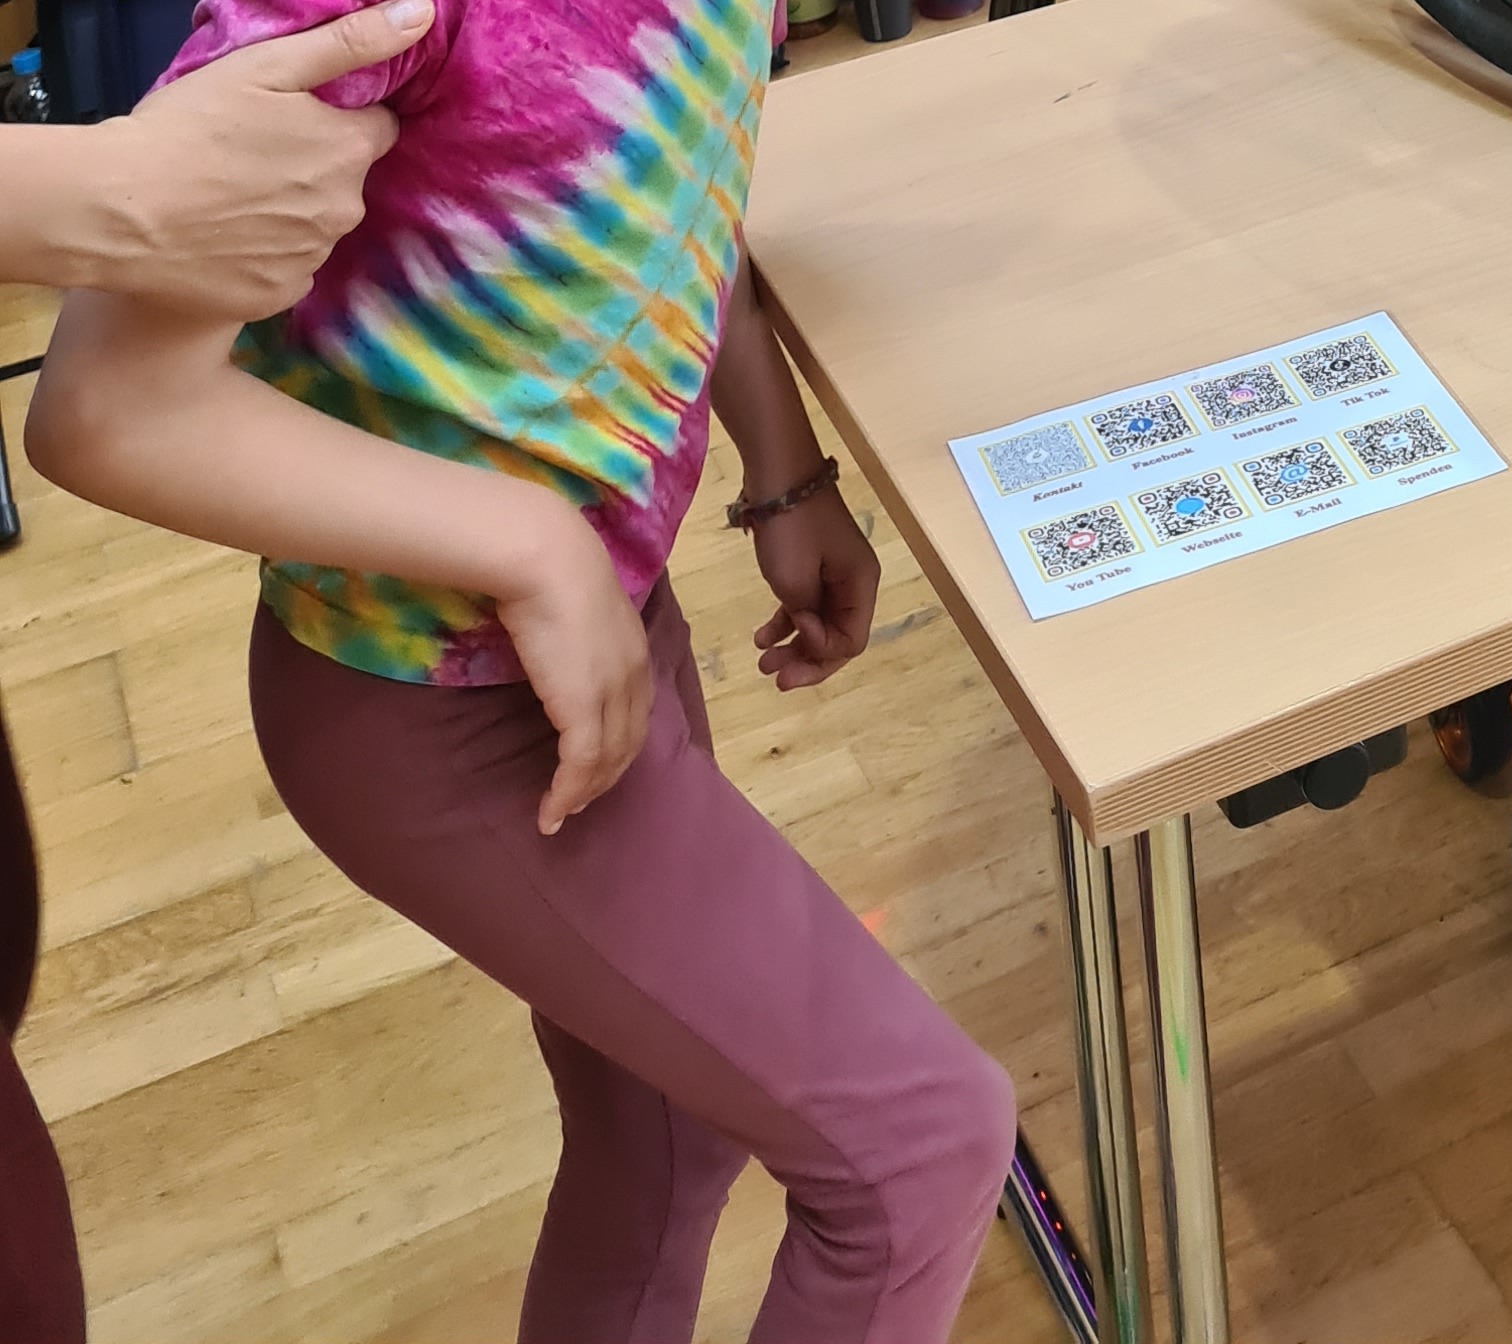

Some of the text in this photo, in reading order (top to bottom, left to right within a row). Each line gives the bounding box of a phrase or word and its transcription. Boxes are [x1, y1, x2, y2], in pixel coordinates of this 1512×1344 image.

[1340, 387, 1390, 407] Tik Tok
[1231, 416, 1298, 440] Instagram
[1131, 447, 1195, 470] Facebook
[1397, 463, 1453, 486] Spenden
[1032, 481, 1083, 503] Kontakt
[1295, 498, 1342, 518] E-Mail
[1181, 530, 1243, 554] Webseite
[1066, 565, 1132, 592] You Tube
